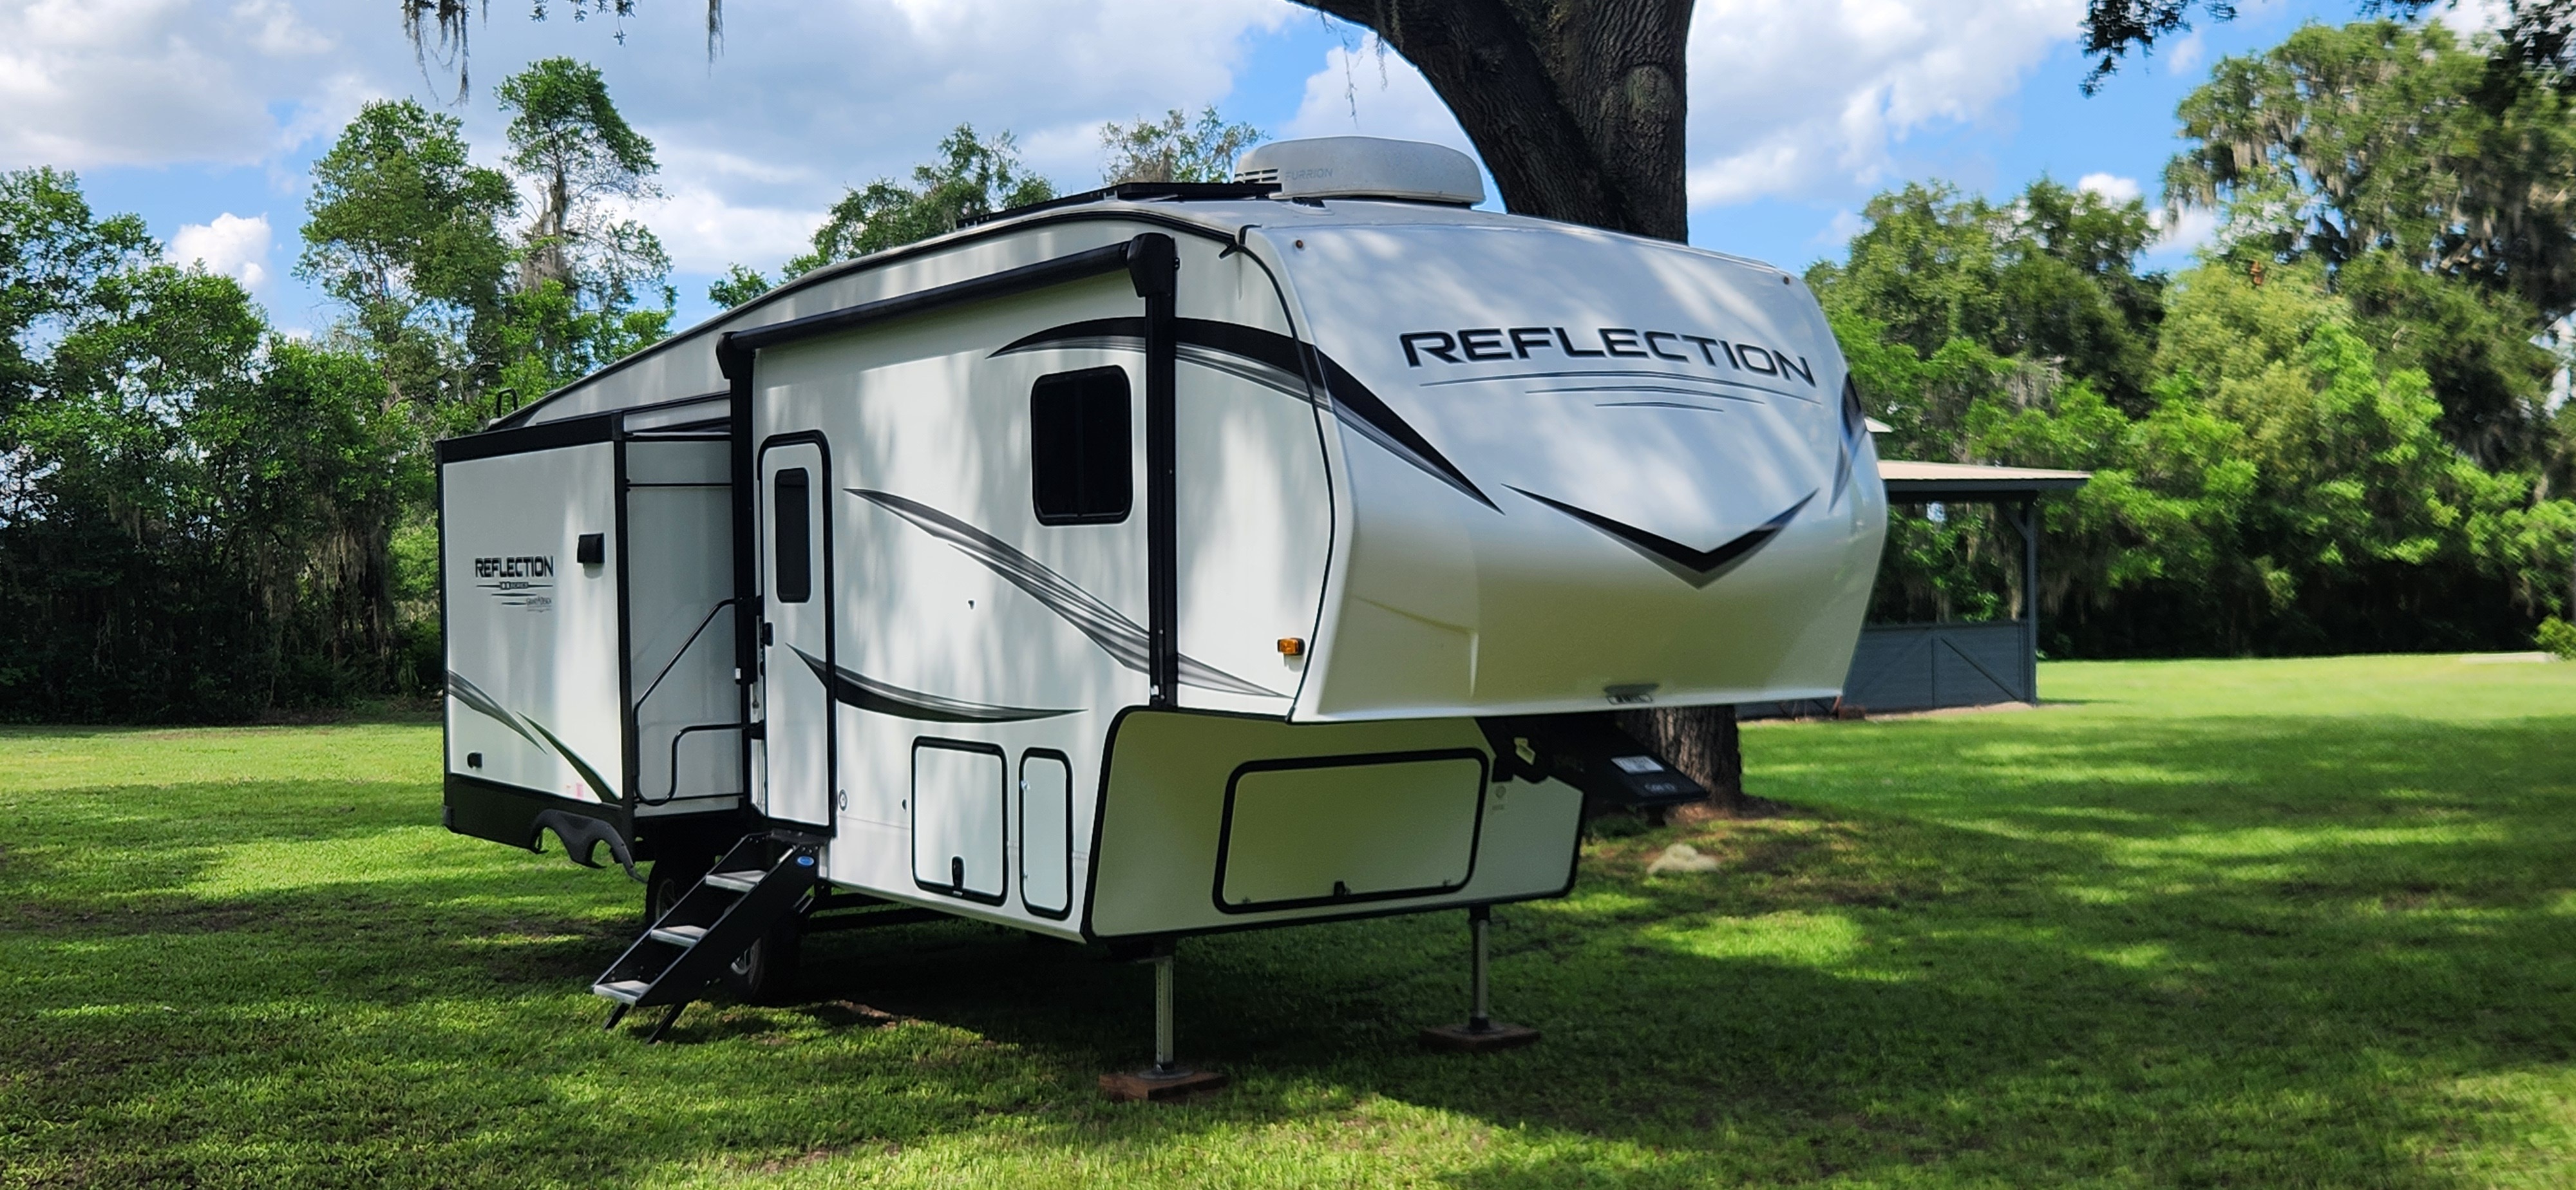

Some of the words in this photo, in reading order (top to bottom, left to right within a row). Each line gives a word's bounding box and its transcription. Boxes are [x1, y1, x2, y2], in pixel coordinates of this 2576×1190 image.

[1285, 168, 1333, 181] FURRION
[1399, 326, 1817, 388] REFLECTION
[475, 556, 554, 578] REFLECTION
